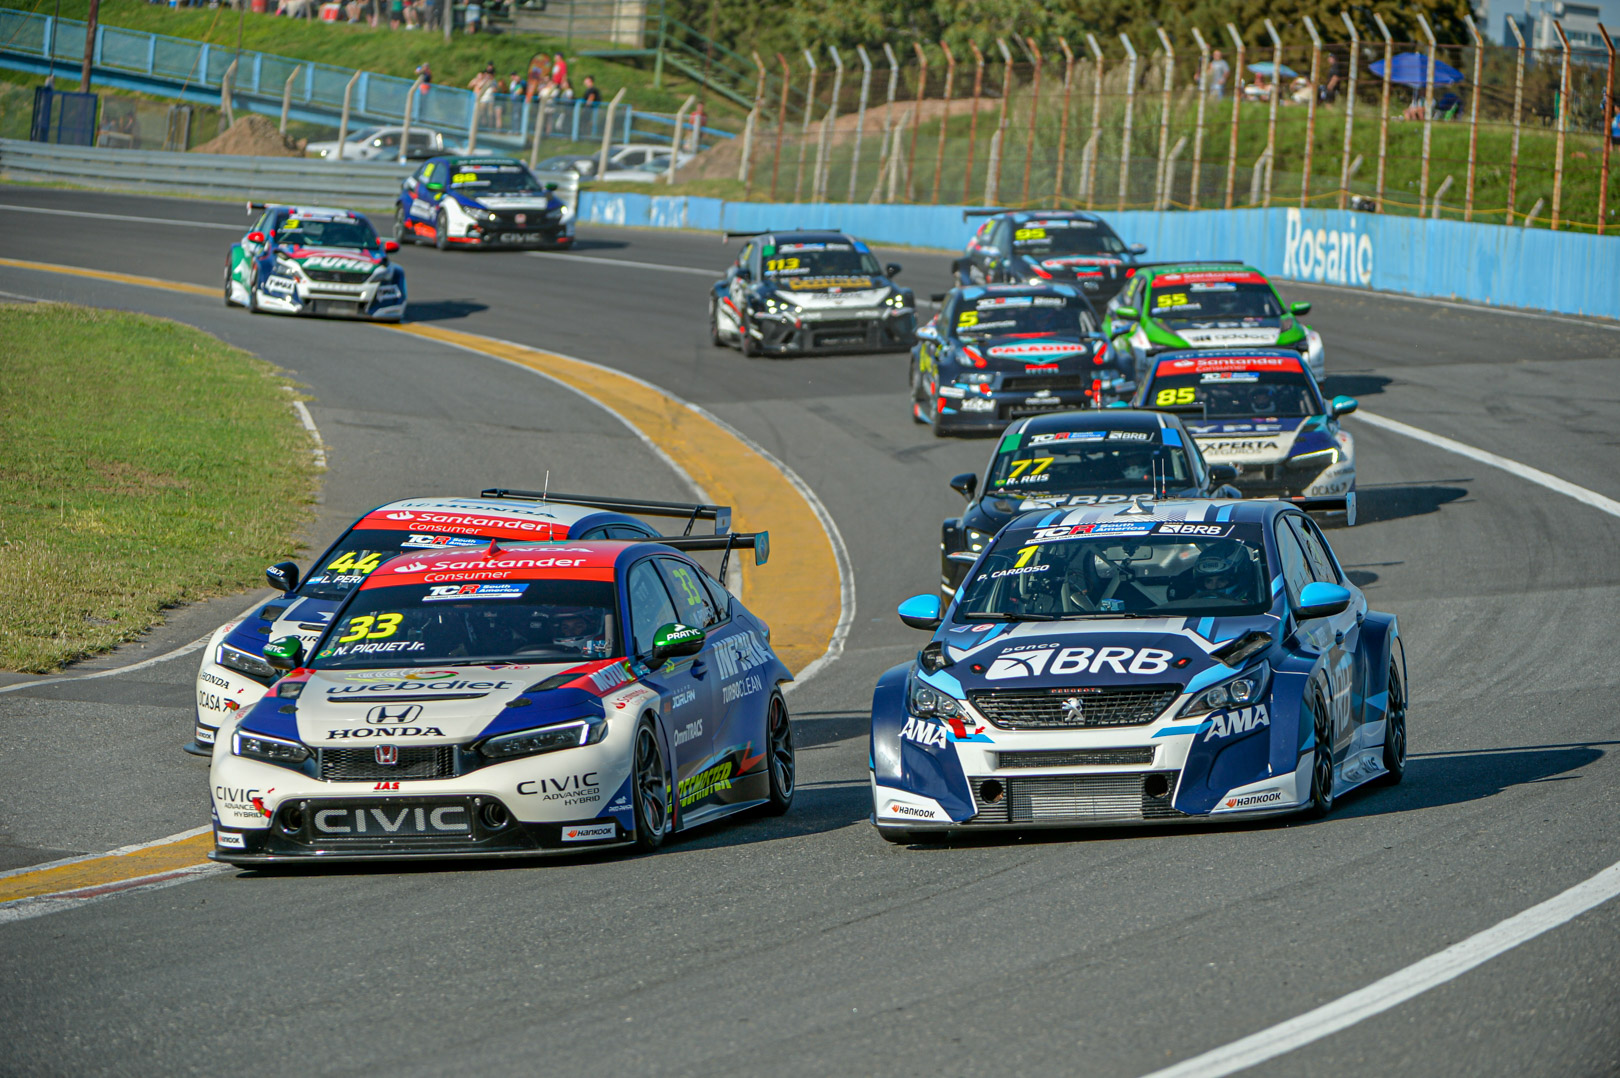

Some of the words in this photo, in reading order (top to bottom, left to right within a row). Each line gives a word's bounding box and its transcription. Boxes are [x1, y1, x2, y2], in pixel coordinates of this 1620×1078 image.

[284, 219, 300, 229] 3
[1015, 228, 1046, 241] 95
[1283, 206, 1373, 286] Rosario
[302, 256, 374, 273] PUMA
[767, 257, 800, 271] 113
[1157, 292, 1188, 308] 55
[957, 311, 979, 327] 5
[1197, 358, 1284, 366] Santander
[1156, 387, 1196, 406] 85
[1186, 424, 1282, 433] YPF
[1122, 432, 1148, 440] BRB
[1008, 457, 1055, 479] 77
[1020, 473, 1050, 484] REIS
[432, 504, 557, 518] HONDA
[408, 522, 482, 534] Consumer
[416, 513, 548, 531] Santander
[1033, 524, 1097, 539] TCR
[1180, 524, 1222, 536] BRB
[408, 534, 451, 545] TCR
[446, 547, 594, 555] HNDA
[1013, 545, 1040, 569] 1
[327, 552, 382, 574] 44
[430, 558, 587, 571] Santander
[424, 571, 512, 582] Consumer
[990, 564, 1050, 579] CARDOSO
[333, 575, 365, 584] PER
[429, 584, 481, 596] TCR
[672, 568, 701, 606] 33
[339, 613, 404, 643] 33
[332, 646, 348, 656] N.
[351, 642, 409, 654] PIQUET
[406, 641, 425, 651] Jr.
[1001, 642, 1060, 654] banco
[1049, 646, 1174, 675] BRB
[201, 672, 230, 689] HONDA
[326, 681, 513, 694] webdiet
[1203, 703, 1271, 742] AMA
[326, 727, 446, 740] HONDA
[673, 719, 703, 747] OmniTRACS
[898, 717, 947, 749] AMA
[373, 782, 400, 790] JAS
[516, 772, 600, 795] CIVIC
[216, 786, 263, 802] CIVIC
[542, 787, 600, 801] ADVANCED
[564, 795, 600, 806] HYBRID
[224, 803, 257, 811] ADVANCE
[314, 806, 468, 833] CIVIC
